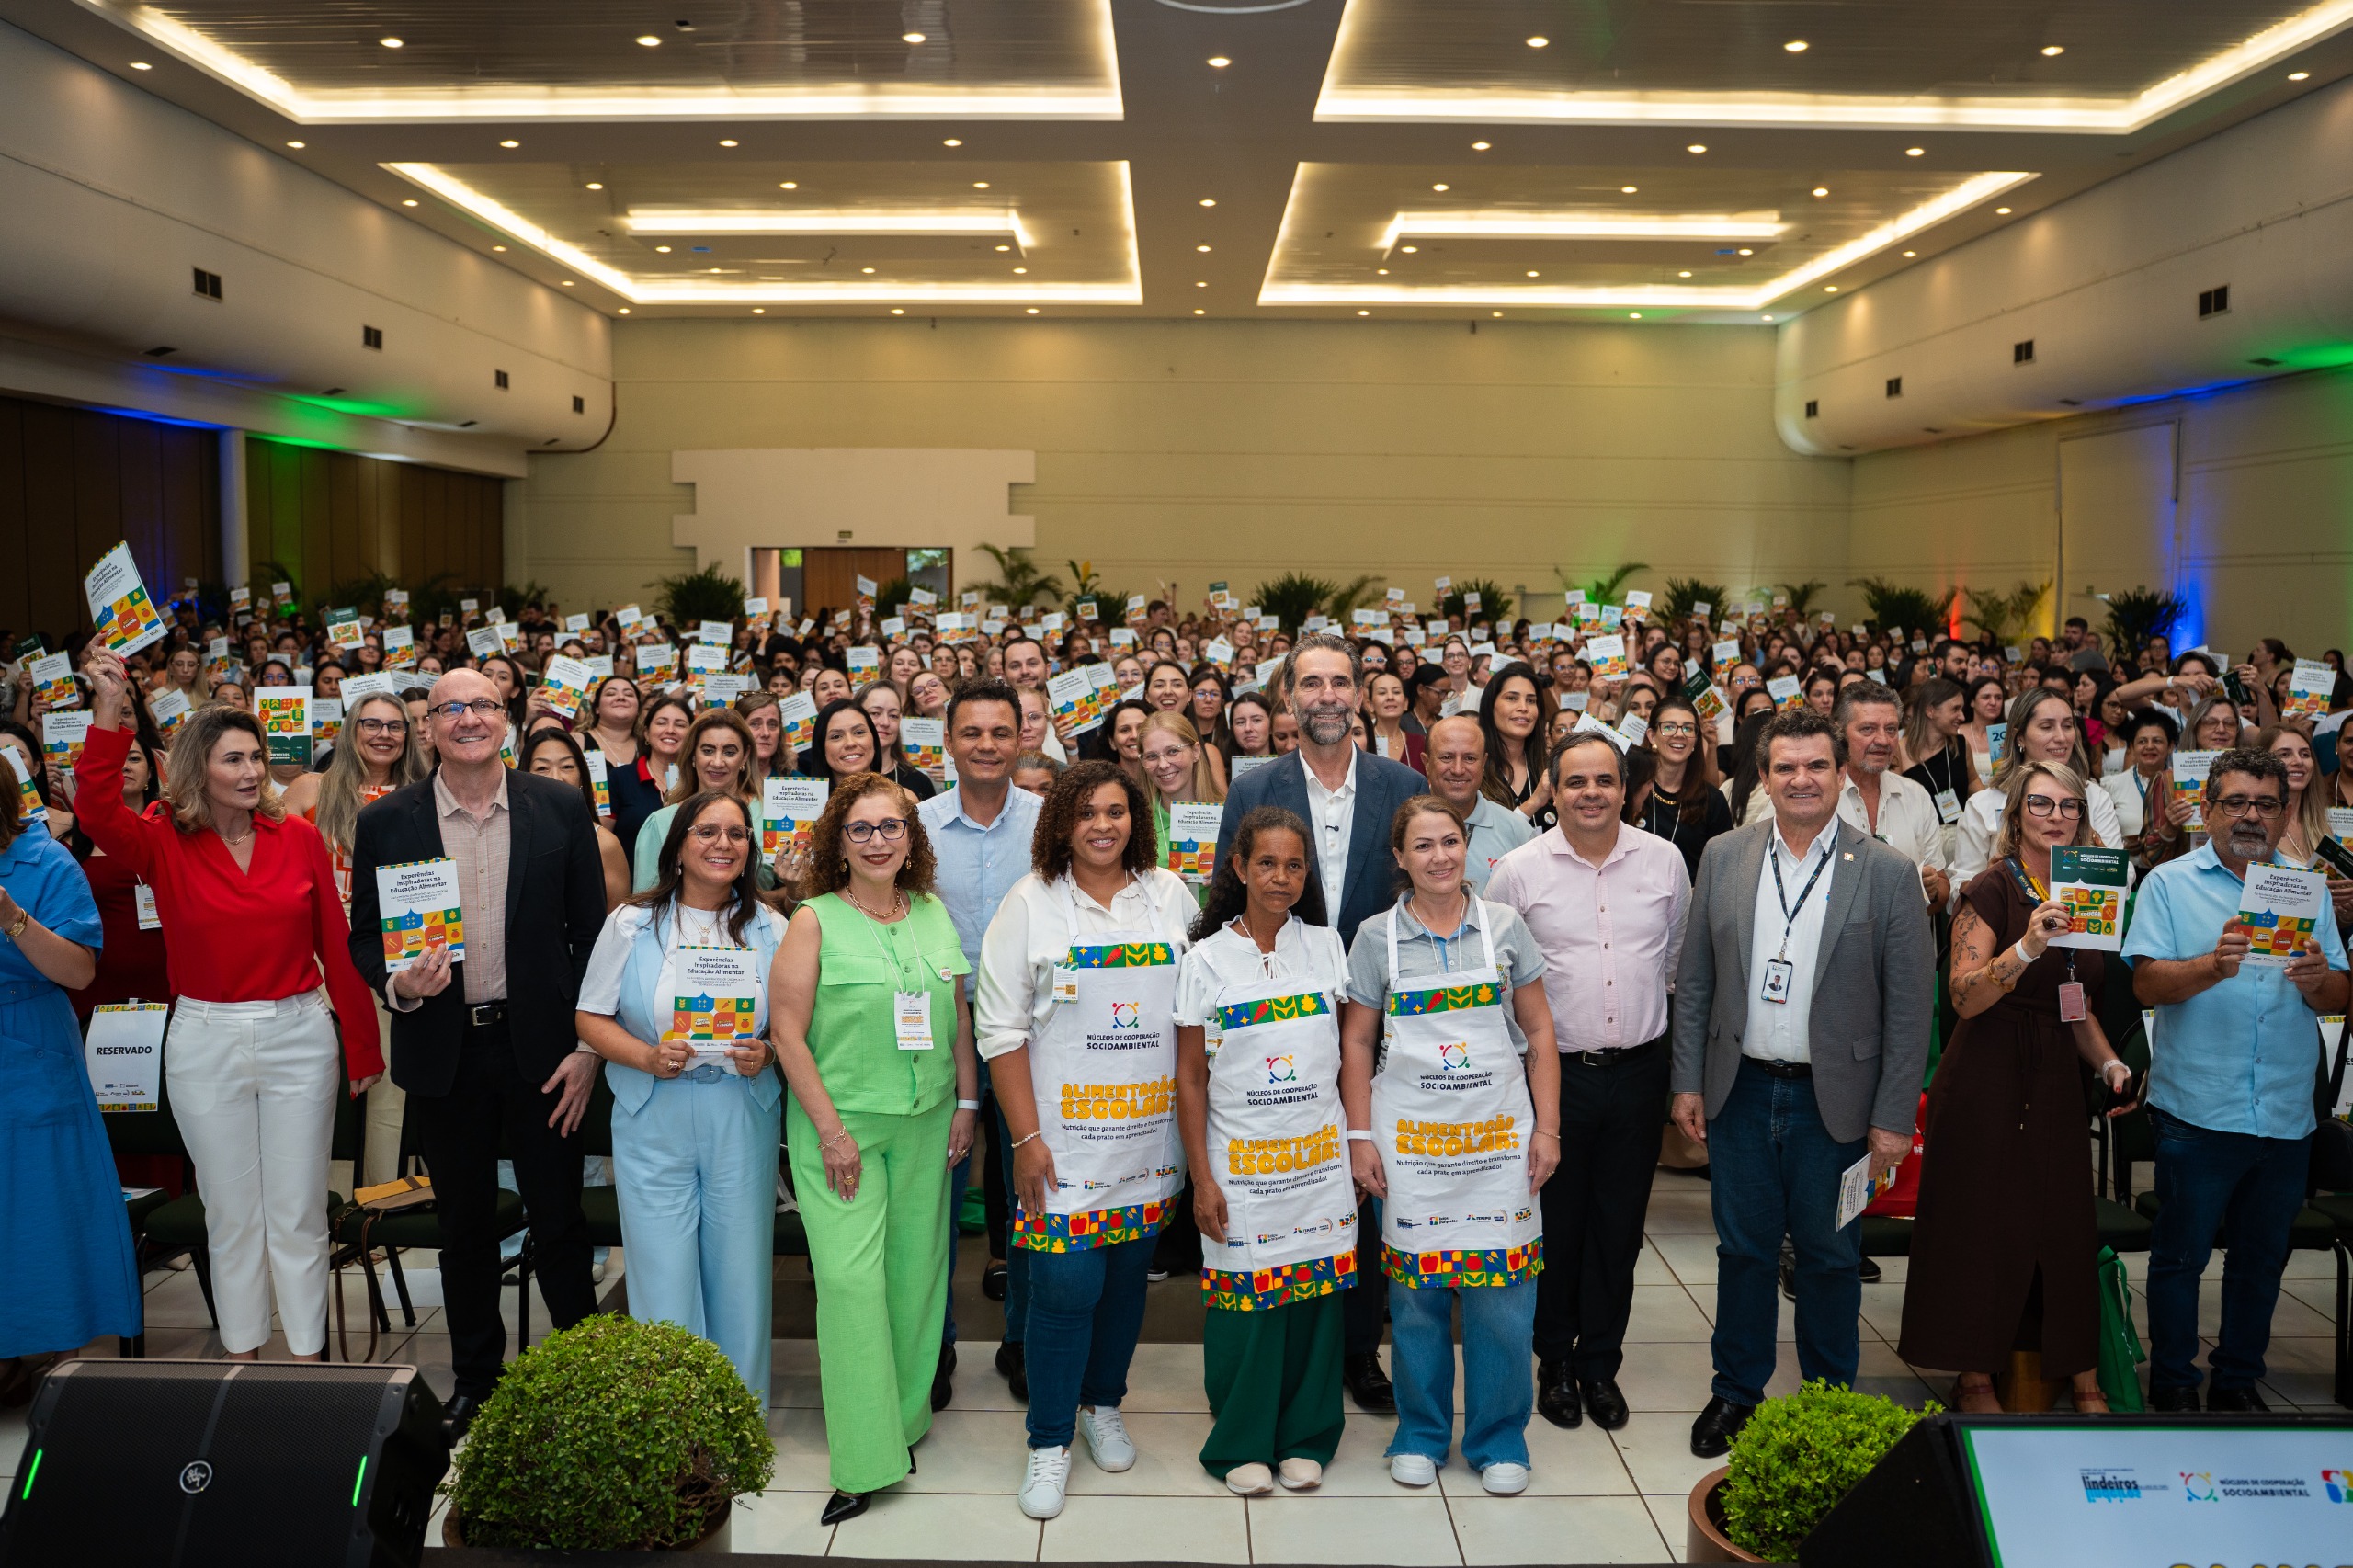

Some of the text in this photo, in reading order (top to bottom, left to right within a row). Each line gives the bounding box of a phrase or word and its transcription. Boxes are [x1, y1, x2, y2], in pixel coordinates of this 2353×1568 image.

[1123, 1032, 1160, 1040] COOPERAÇÃO
[1086, 1040, 1160, 1050] SOCIOAMBIENTAL
[97, 1046, 152, 1055] RESERVADO
[1456, 1071, 1493, 1081] COOPERAÇÃO
[1061, 1074, 1178, 1099] ALIMENTAÇÃO
[1281, 1083, 1318, 1094] COOPERAÇÃO
[1420, 1079, 1493, 1091] SOCIOAMBIENTAL
[1247, 1092, 1319, 1106] SOCIOAMBIENTAL
[1060, 1094, 1177, 1120] ESCOLAR:
[1062, 1123, 1087, 1131] Nutrição
[1396, 1113, 1515, 1137] ALIMENTAÇÃO
[1097, 1133, 1114, 1142] prato
[1228, 1123, 1338, 1154] ALIMENTAÇÃO
[1396, 1131, 1519, 1157] ESCOLAR:
[1228, 1142, 1341, 1176] ESCOLAR:
[1488, 1154, 1521, 1163] transforma
[1462, 1164, 1502, 1176] aprendizado!
[1268, 1177, 1292, 1187] garante
[1265, 1187, 1282, 1196] prato
[2081, 1475, 2139, 1490] lindeiros
[2260, 1478, 2305, 1486] COOPERAÇÃO
[2222, 1488, 2311, 1497] SOCIOAMBIENTAL
